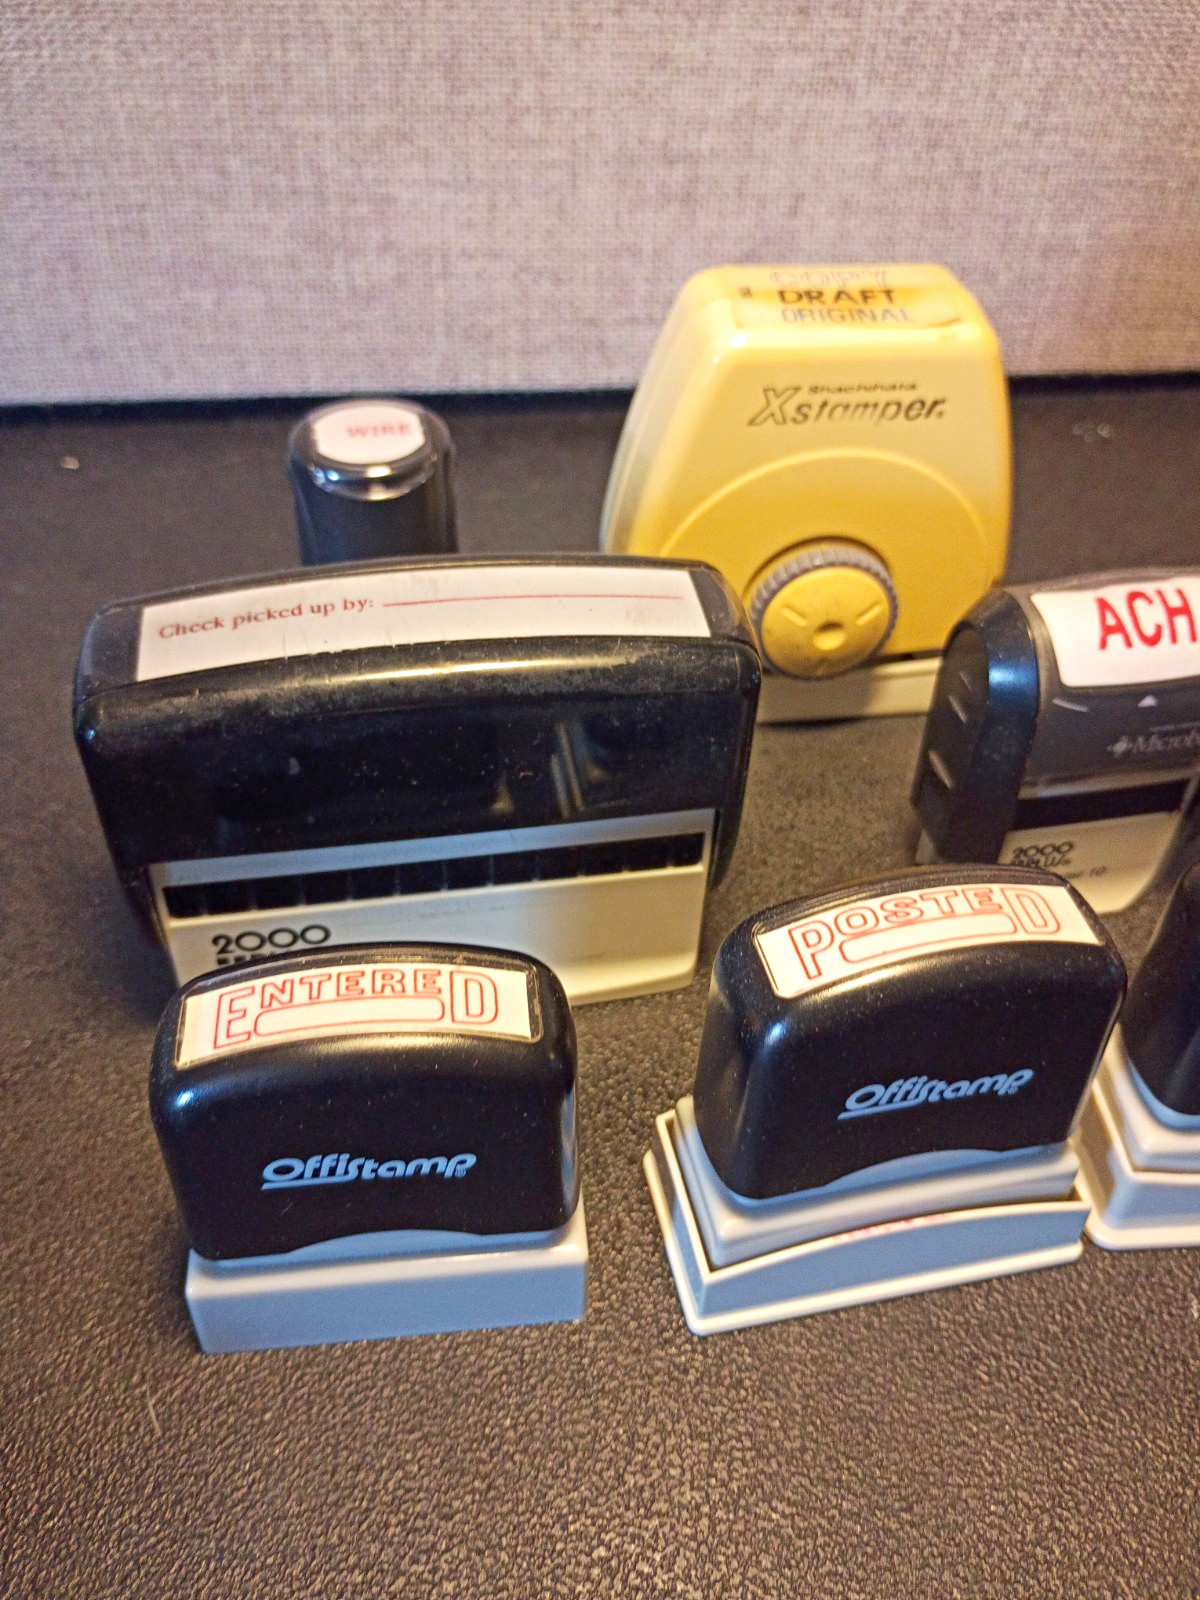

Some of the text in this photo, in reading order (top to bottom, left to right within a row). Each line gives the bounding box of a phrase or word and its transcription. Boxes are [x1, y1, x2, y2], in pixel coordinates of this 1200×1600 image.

[777, 289, 896, 305] DRAFT
[781, 308, 911, 323] ORIGINAL
[346, 423, 412, 438] WIRE
[159, 598, 374, 639] Check picked up by:
[1096, 587, 1197, 650] ACH
[1012, 841, 1074, 859] 2000
[212, 924, 331, 955] 2000
[787, 886, 1061, 980] POSTED
[213, 969, 499, 1050] ENTERED
